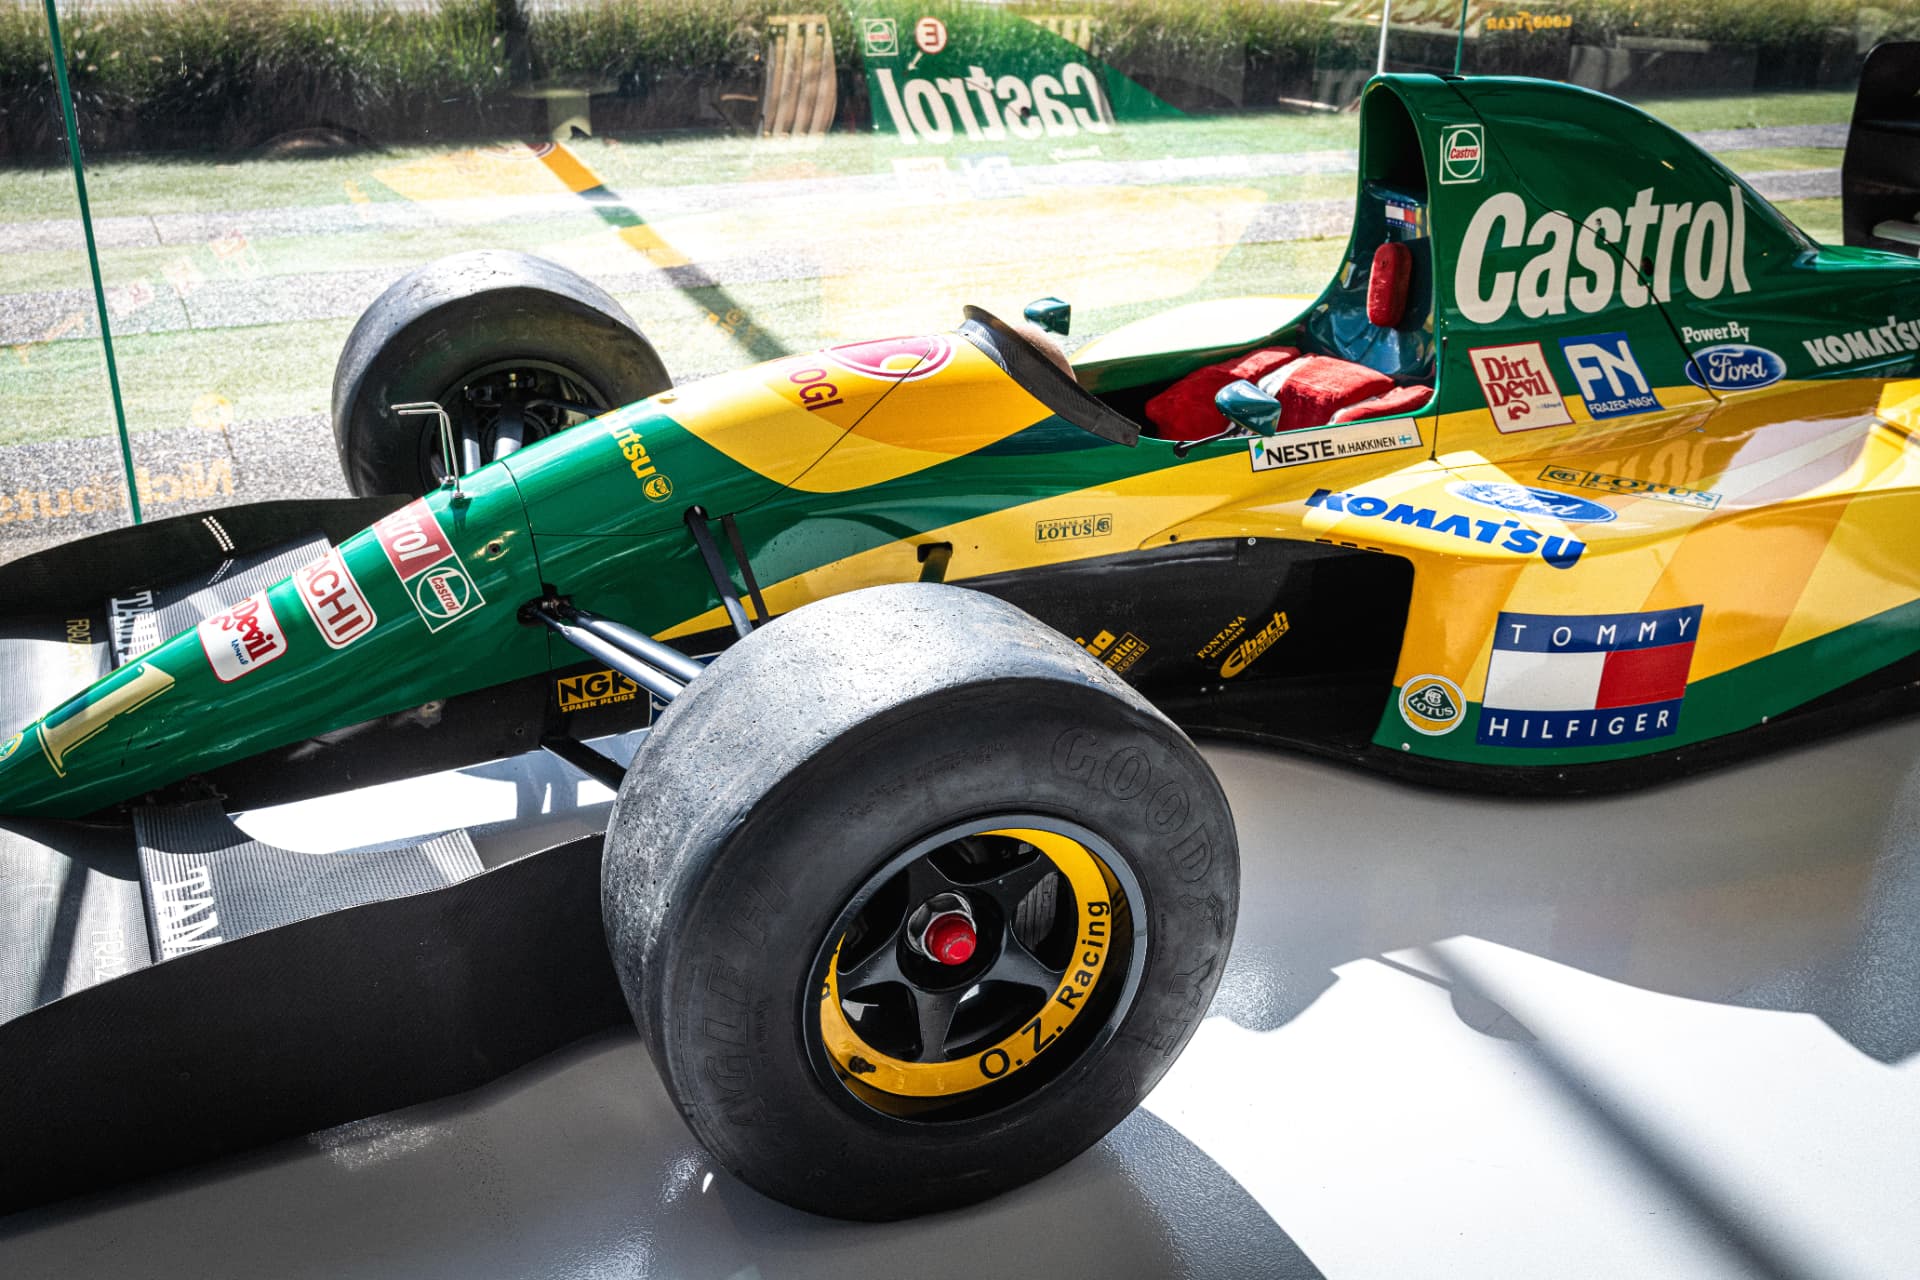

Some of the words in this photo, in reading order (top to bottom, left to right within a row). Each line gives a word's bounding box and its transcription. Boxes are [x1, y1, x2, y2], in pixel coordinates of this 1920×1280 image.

[1450, 147, 1479, 160] Castrol
[1454, 185, 1752, 324] Castrol
[1481, 355, 1534, 382] Dirt
[1564, 340, 1650, 401] FN
[1708, 350, 1767, 383] Ford
[1485, 370, 1553, 408] Devil
[1588, 396, 1657, 415] FRAZER-NASH
[1267, 440, 1335, 466] NESTE
[1337, 436, 1397, 455] M.HAKKINEN
[1476, 484, 1584, 518] Ford
[1592, 474, 1713, 502] LOTUS
[1038, 523, 1092, 540] LOTUS
[1305, 488, 1587, 569] KOMATSU
[430, 576, 461, 612] Castrol
[231, 600, 278, 662] Devil
[1197, 616, 1247, 659] FONTANA
[1220, 611, 1288, 678] Eibach
[1511, 617, 1692, 646] TOMMY
[560, 672, 635, 704] NGK
[562, 700, 597, 713] SPARK
[600, 693, 636, 706] PLUGS
[1409, 697, 1454, 717] LOTUS
[1488, 710, 1669, 739] HILFIGER
[1056, 901, 1111, 1010] Racing
